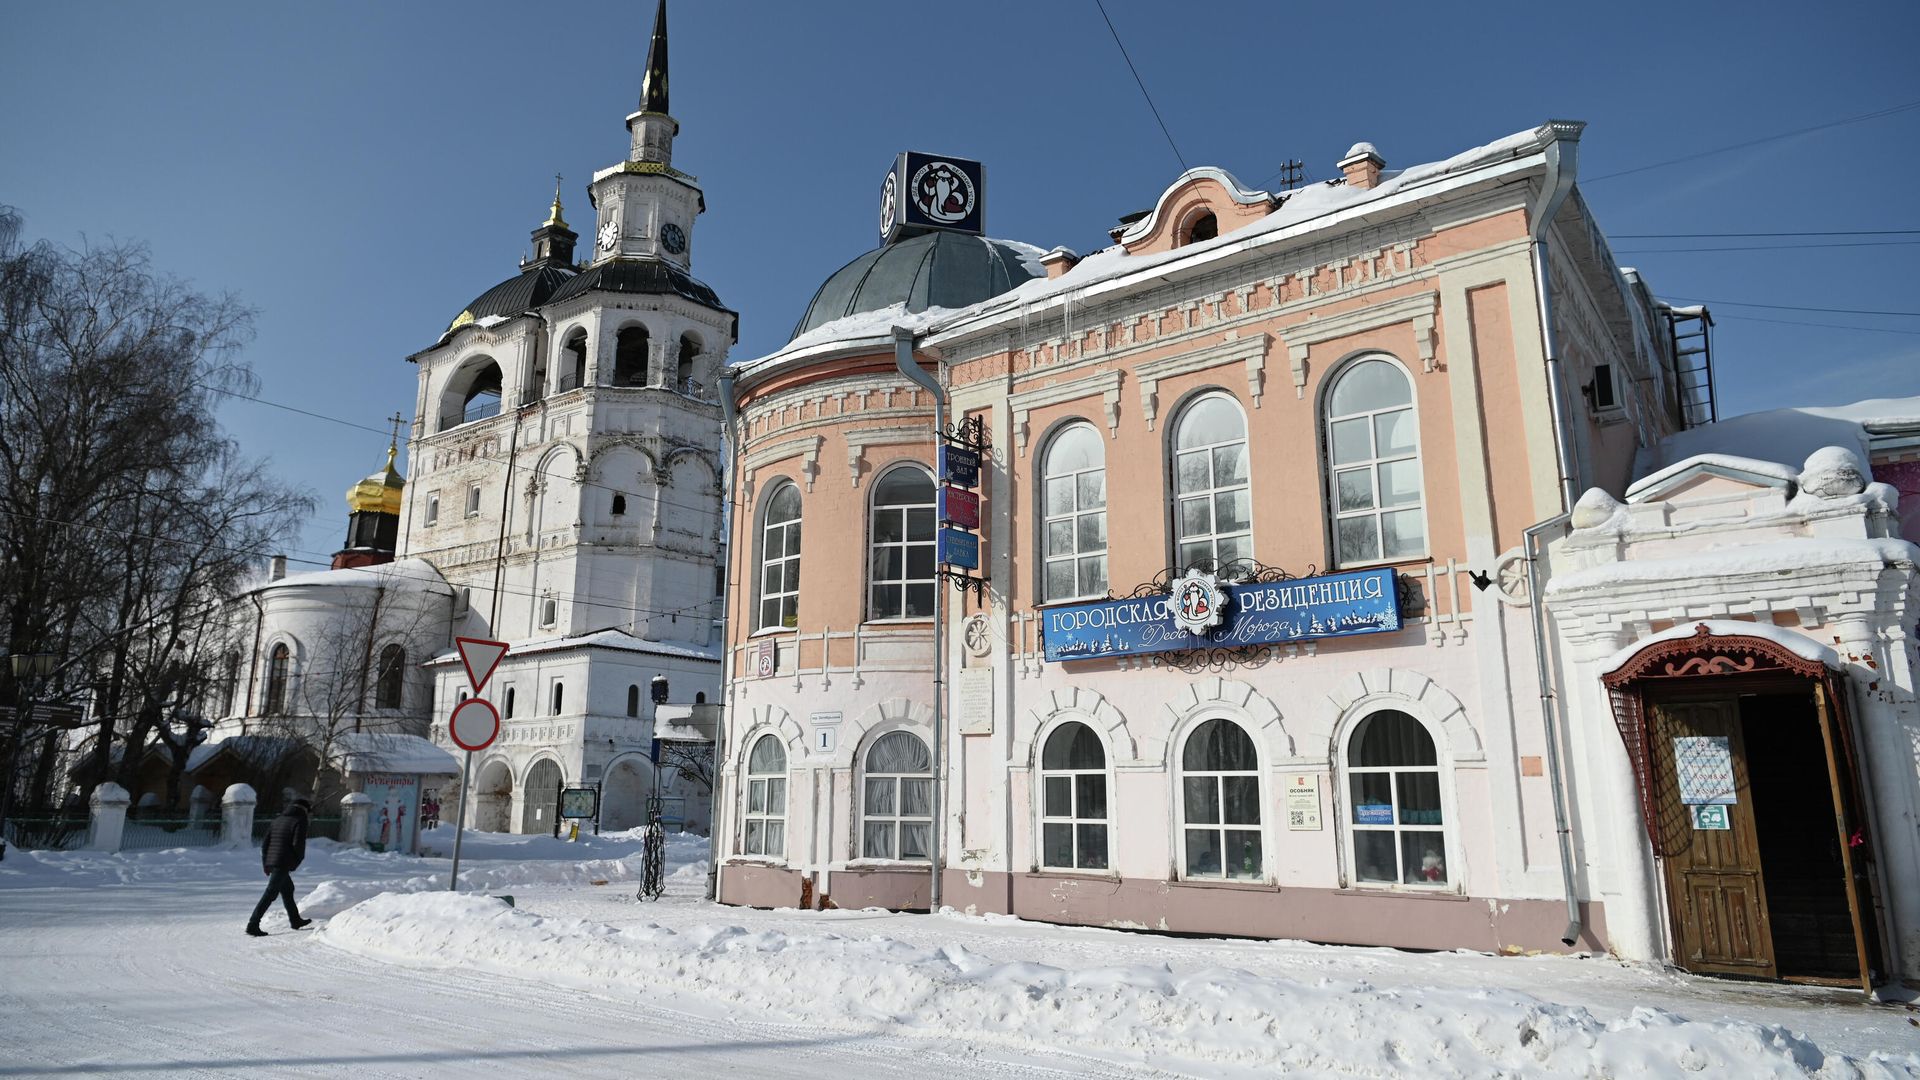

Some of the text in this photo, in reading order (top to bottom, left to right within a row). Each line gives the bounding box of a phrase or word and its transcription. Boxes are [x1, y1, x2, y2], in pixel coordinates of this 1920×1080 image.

[1052, 576, 1383, 632] ГОРОДСКАЯ РЕЗИДЕНЦИЯ
[1138, 614, 1291, 647] Деда Мороза
[821, 732, 828, 748] 1
